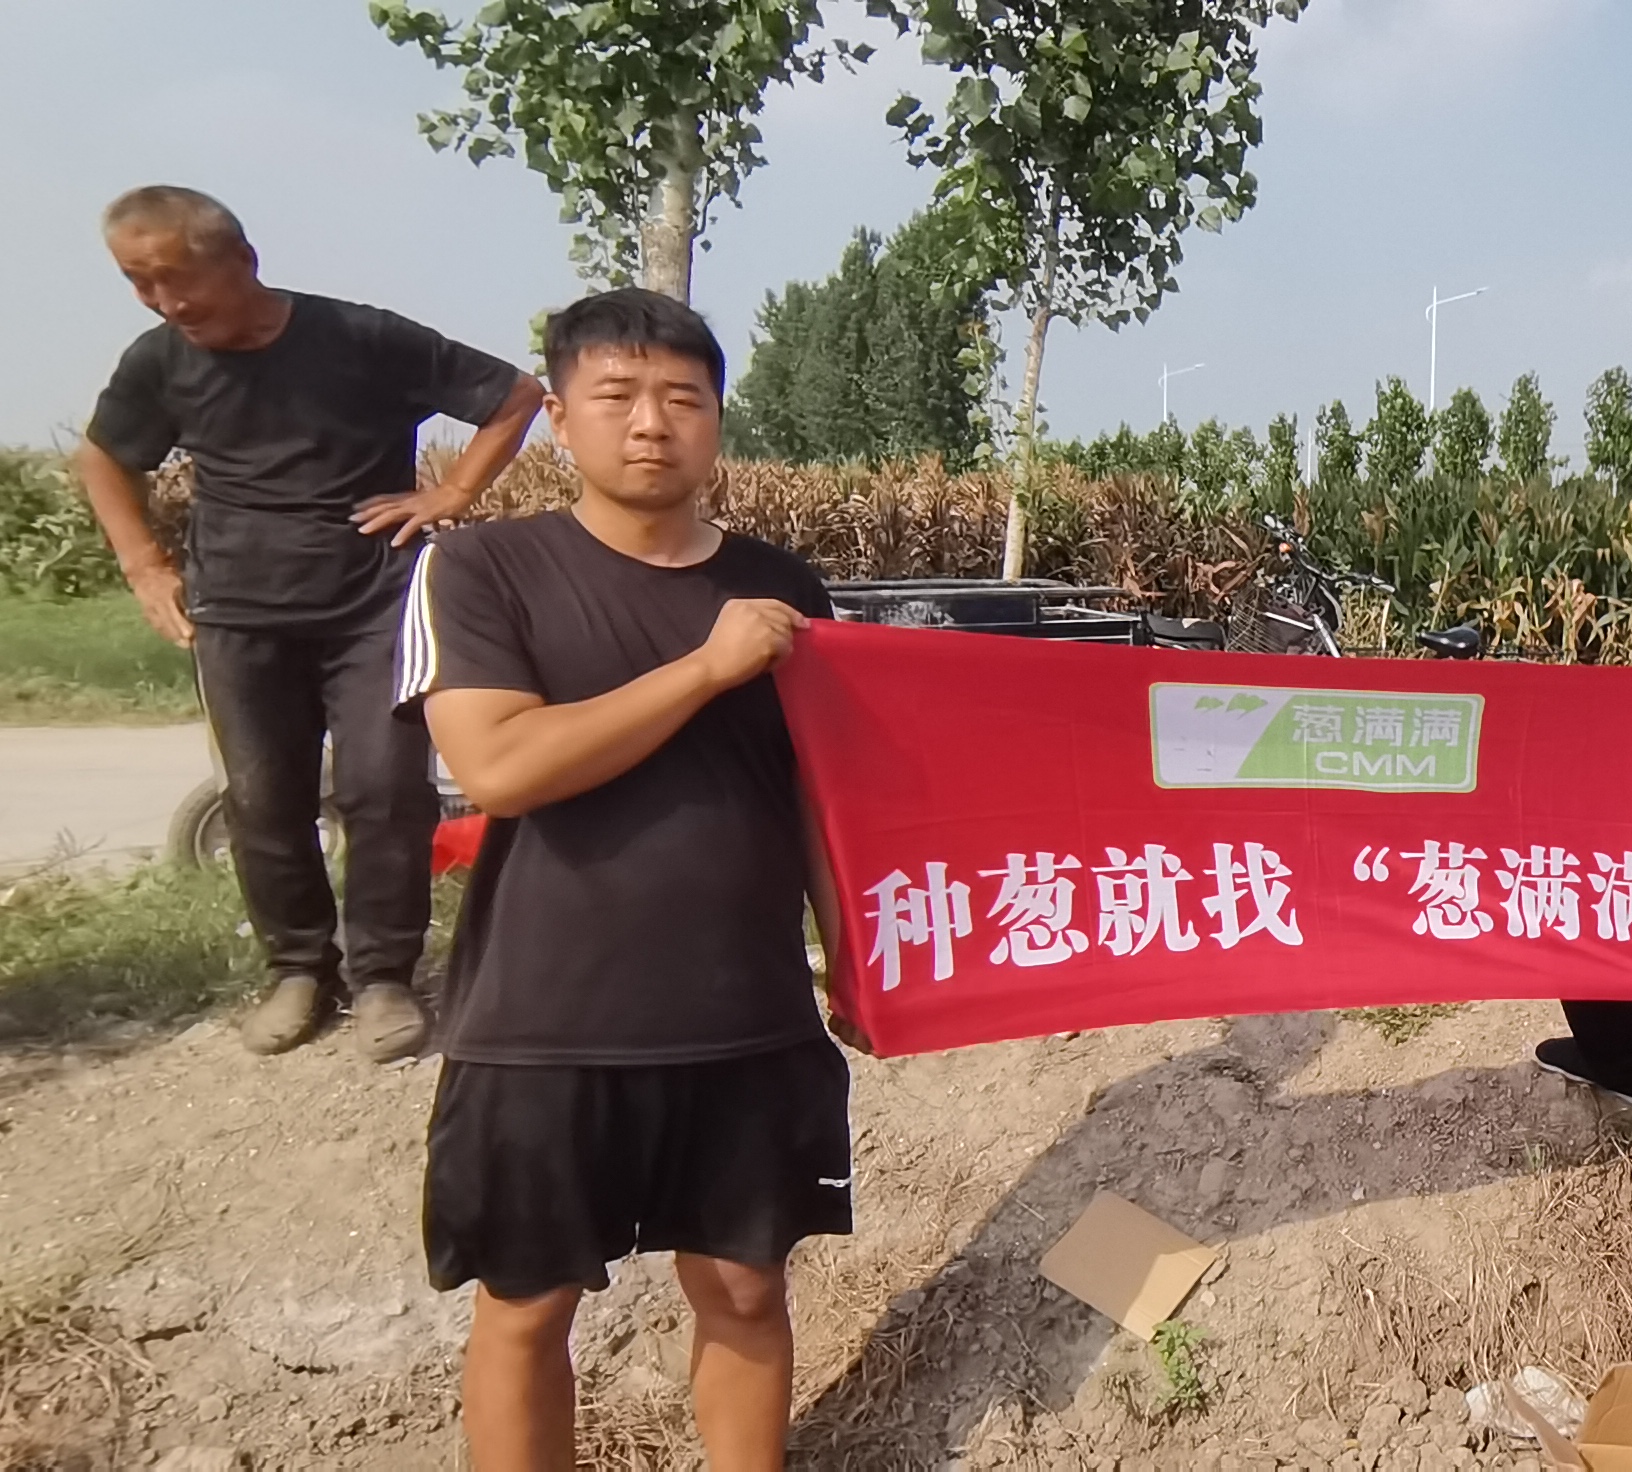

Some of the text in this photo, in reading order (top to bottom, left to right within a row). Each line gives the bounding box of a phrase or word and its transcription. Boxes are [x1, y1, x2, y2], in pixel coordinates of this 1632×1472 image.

[1292, 704, 1462, 748] 葱满满
[1315, 750, 1437, 778] CMM
